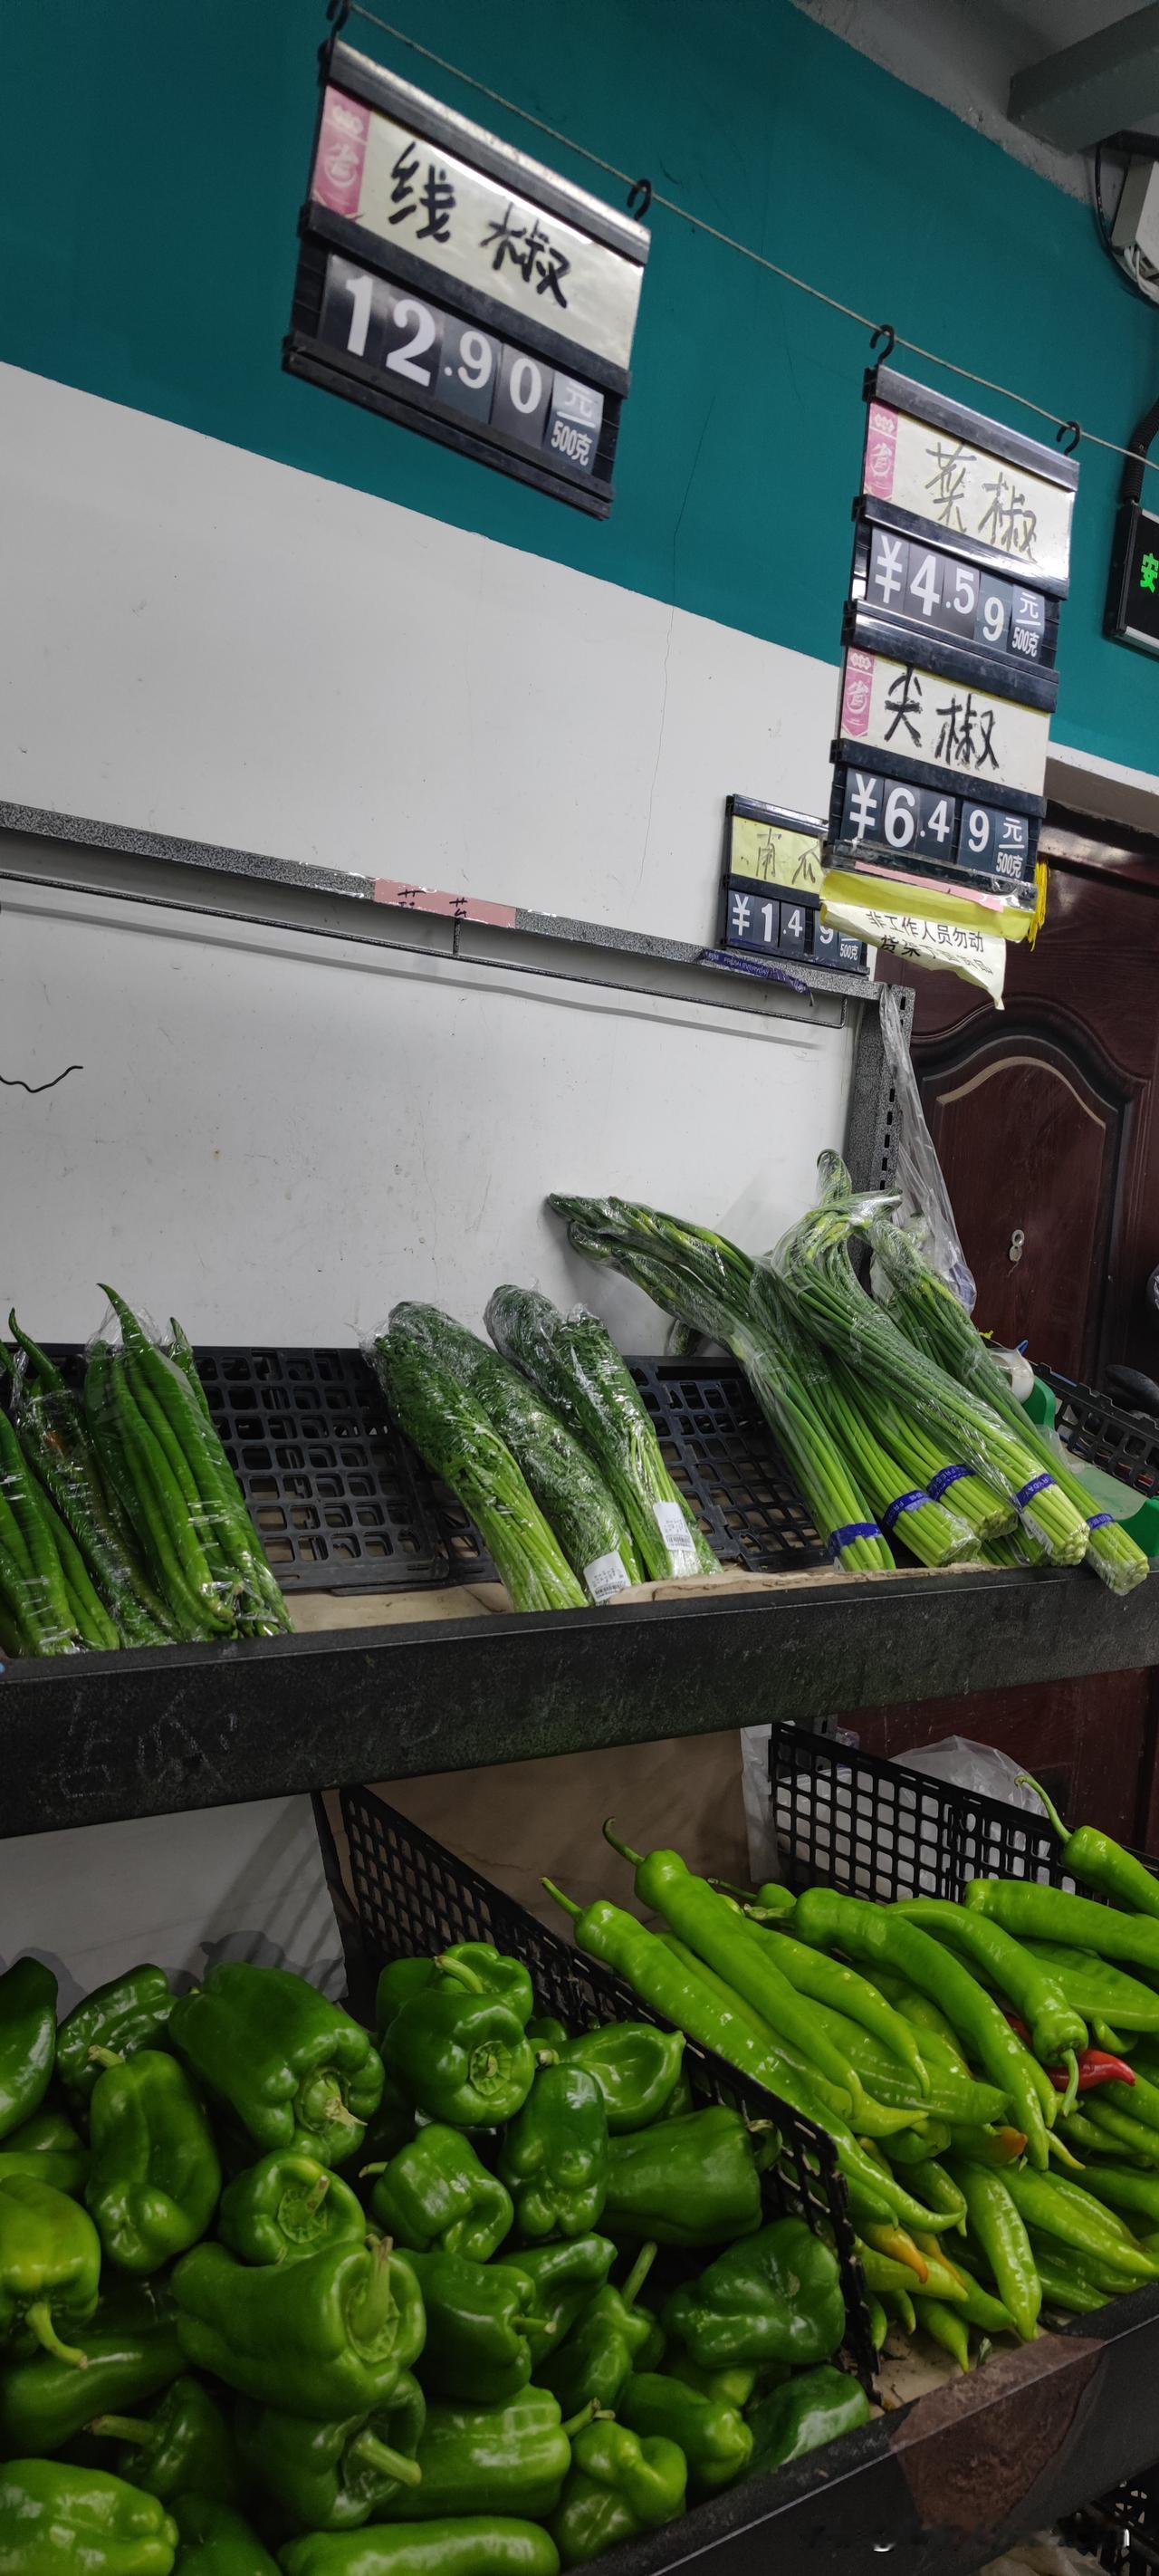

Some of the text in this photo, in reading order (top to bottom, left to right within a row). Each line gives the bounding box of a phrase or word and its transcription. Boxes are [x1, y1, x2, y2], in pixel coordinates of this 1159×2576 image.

[388, 140, 573, 309] 线椒
[345, 275, 542, 416] 12.90
[564, 382, 594, 417] 元
[551, 419, 592, 466] 500克
[925, 439, 1038, 563] 菜椒
[874, 534, 1005, 641] ¥4.59
[1140, 553, 1159, 593] 安
[1020, 591, 1039, 619] 元
[1011, 627, 1039, 658] 500克
[883, 665, 1000, 771] 尖椒
[849, 773, 991, 853] ¥6.49
[1003, 816, 1022, 842] 元
[996, 851, 1023, 879] 500克
[839, 943, 859, 961] 500克
[866, 910, 984, 953] 非工作人员勿动
